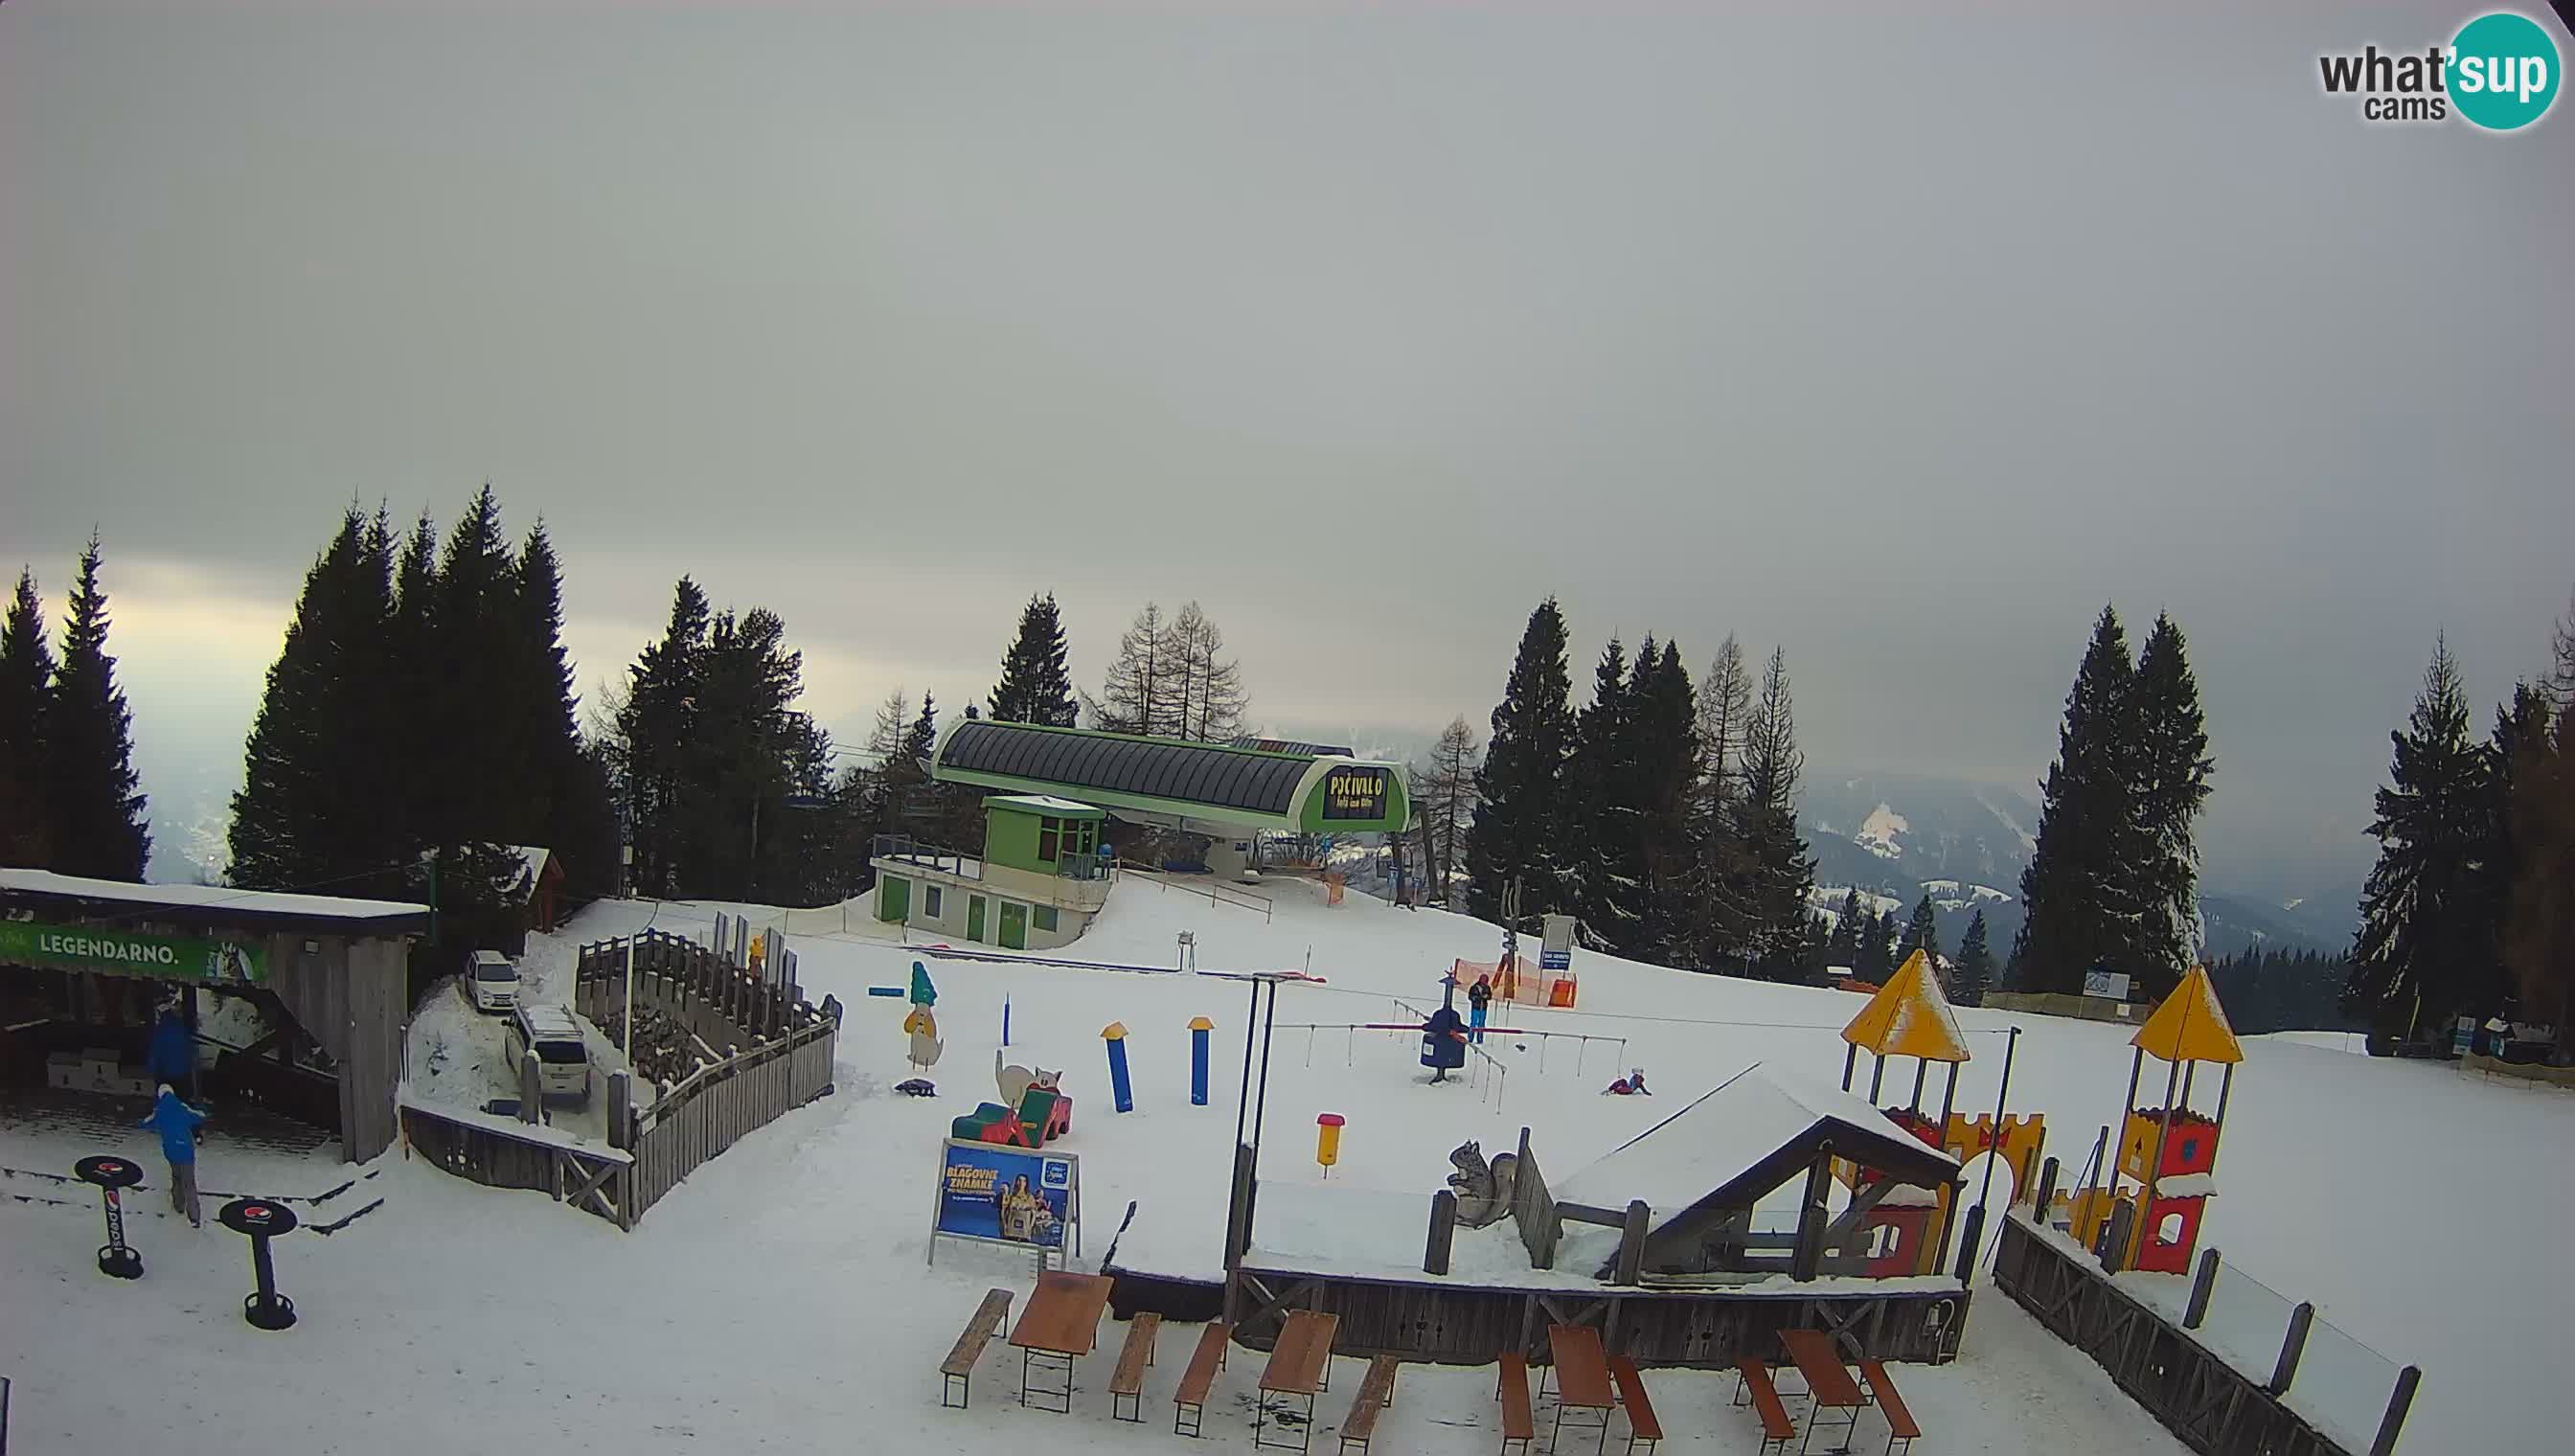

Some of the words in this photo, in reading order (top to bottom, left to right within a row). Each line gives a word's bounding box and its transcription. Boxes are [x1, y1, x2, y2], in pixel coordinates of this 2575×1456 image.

[40, 933, 180, 966] LEGENDARNO.
[949, 1177, 994, 1191] ZNAMKE
[107, 1212, 124, 1251] pepsi
